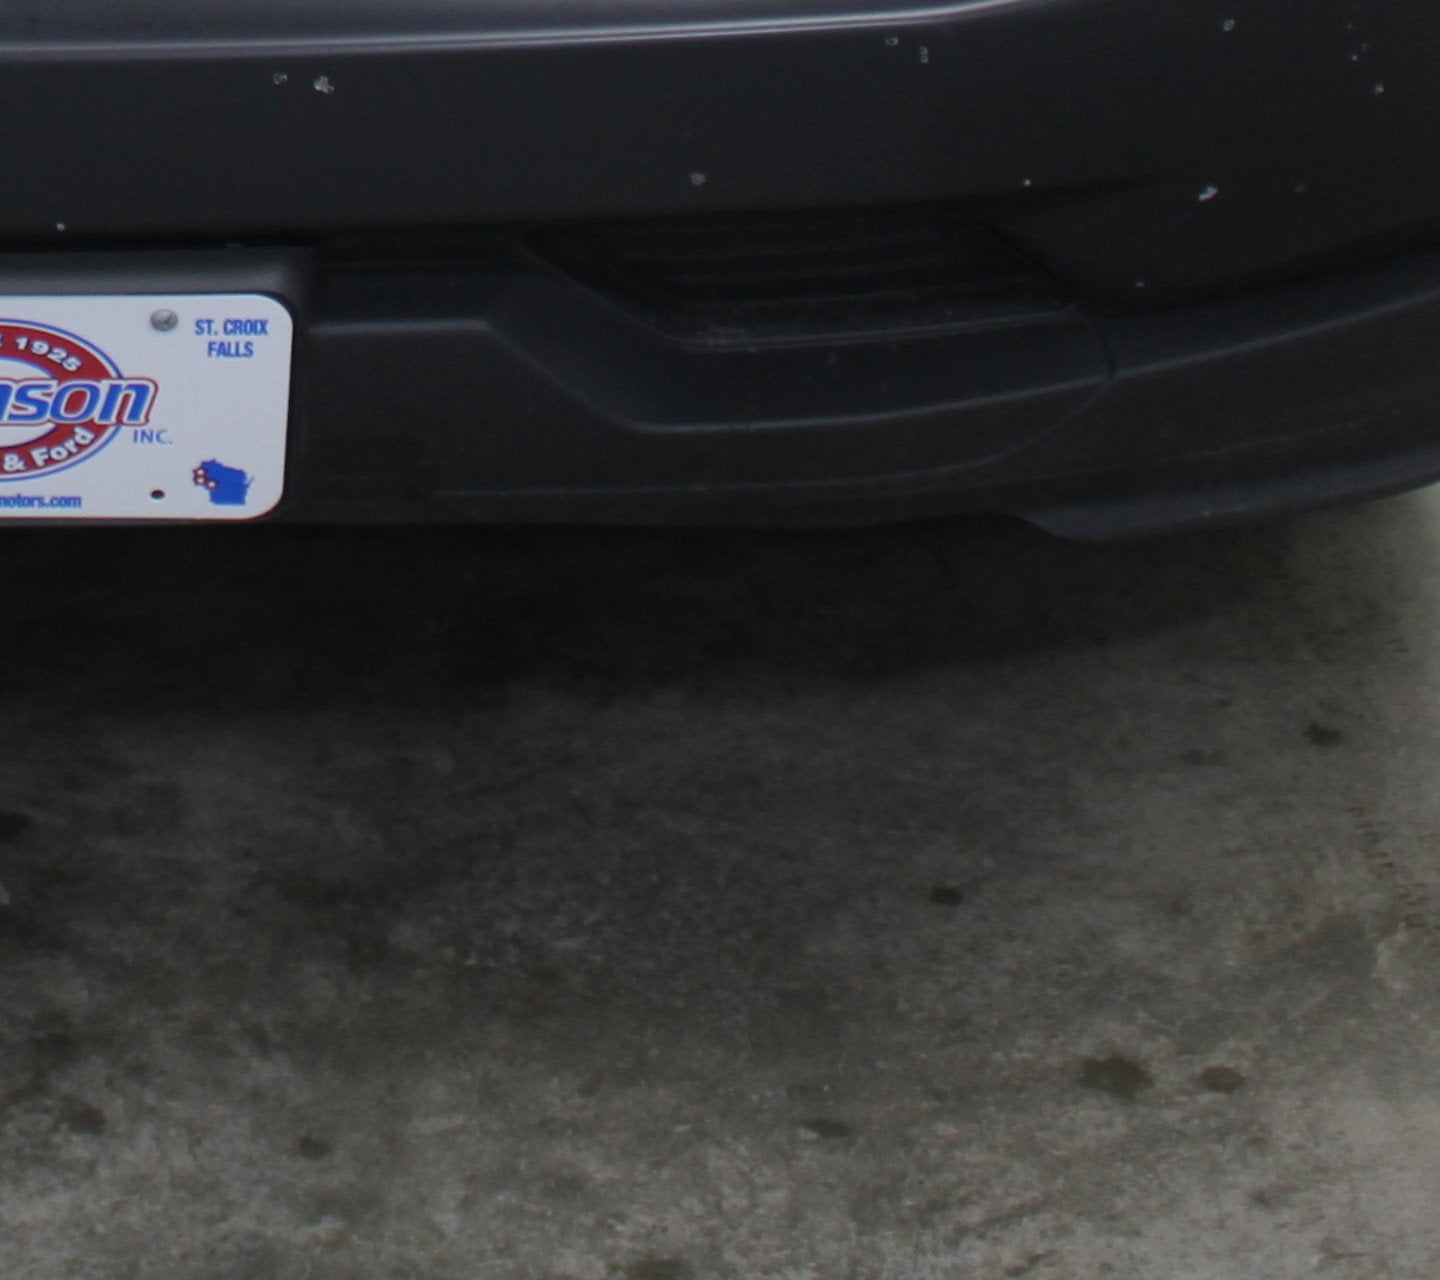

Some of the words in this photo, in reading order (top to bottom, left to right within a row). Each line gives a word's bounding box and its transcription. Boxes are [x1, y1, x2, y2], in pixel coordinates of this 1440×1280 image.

[195, 319, 218, 336] ST.
[223, 319, 269, 336] CROIX
[15, 336, 82, 372] 1925
[207, 340, 254, 358] FALLS
[132, 428, 173, 445] INC.
[3, 453, 26, 472] &
[30, 426, 96, 467] Ford
